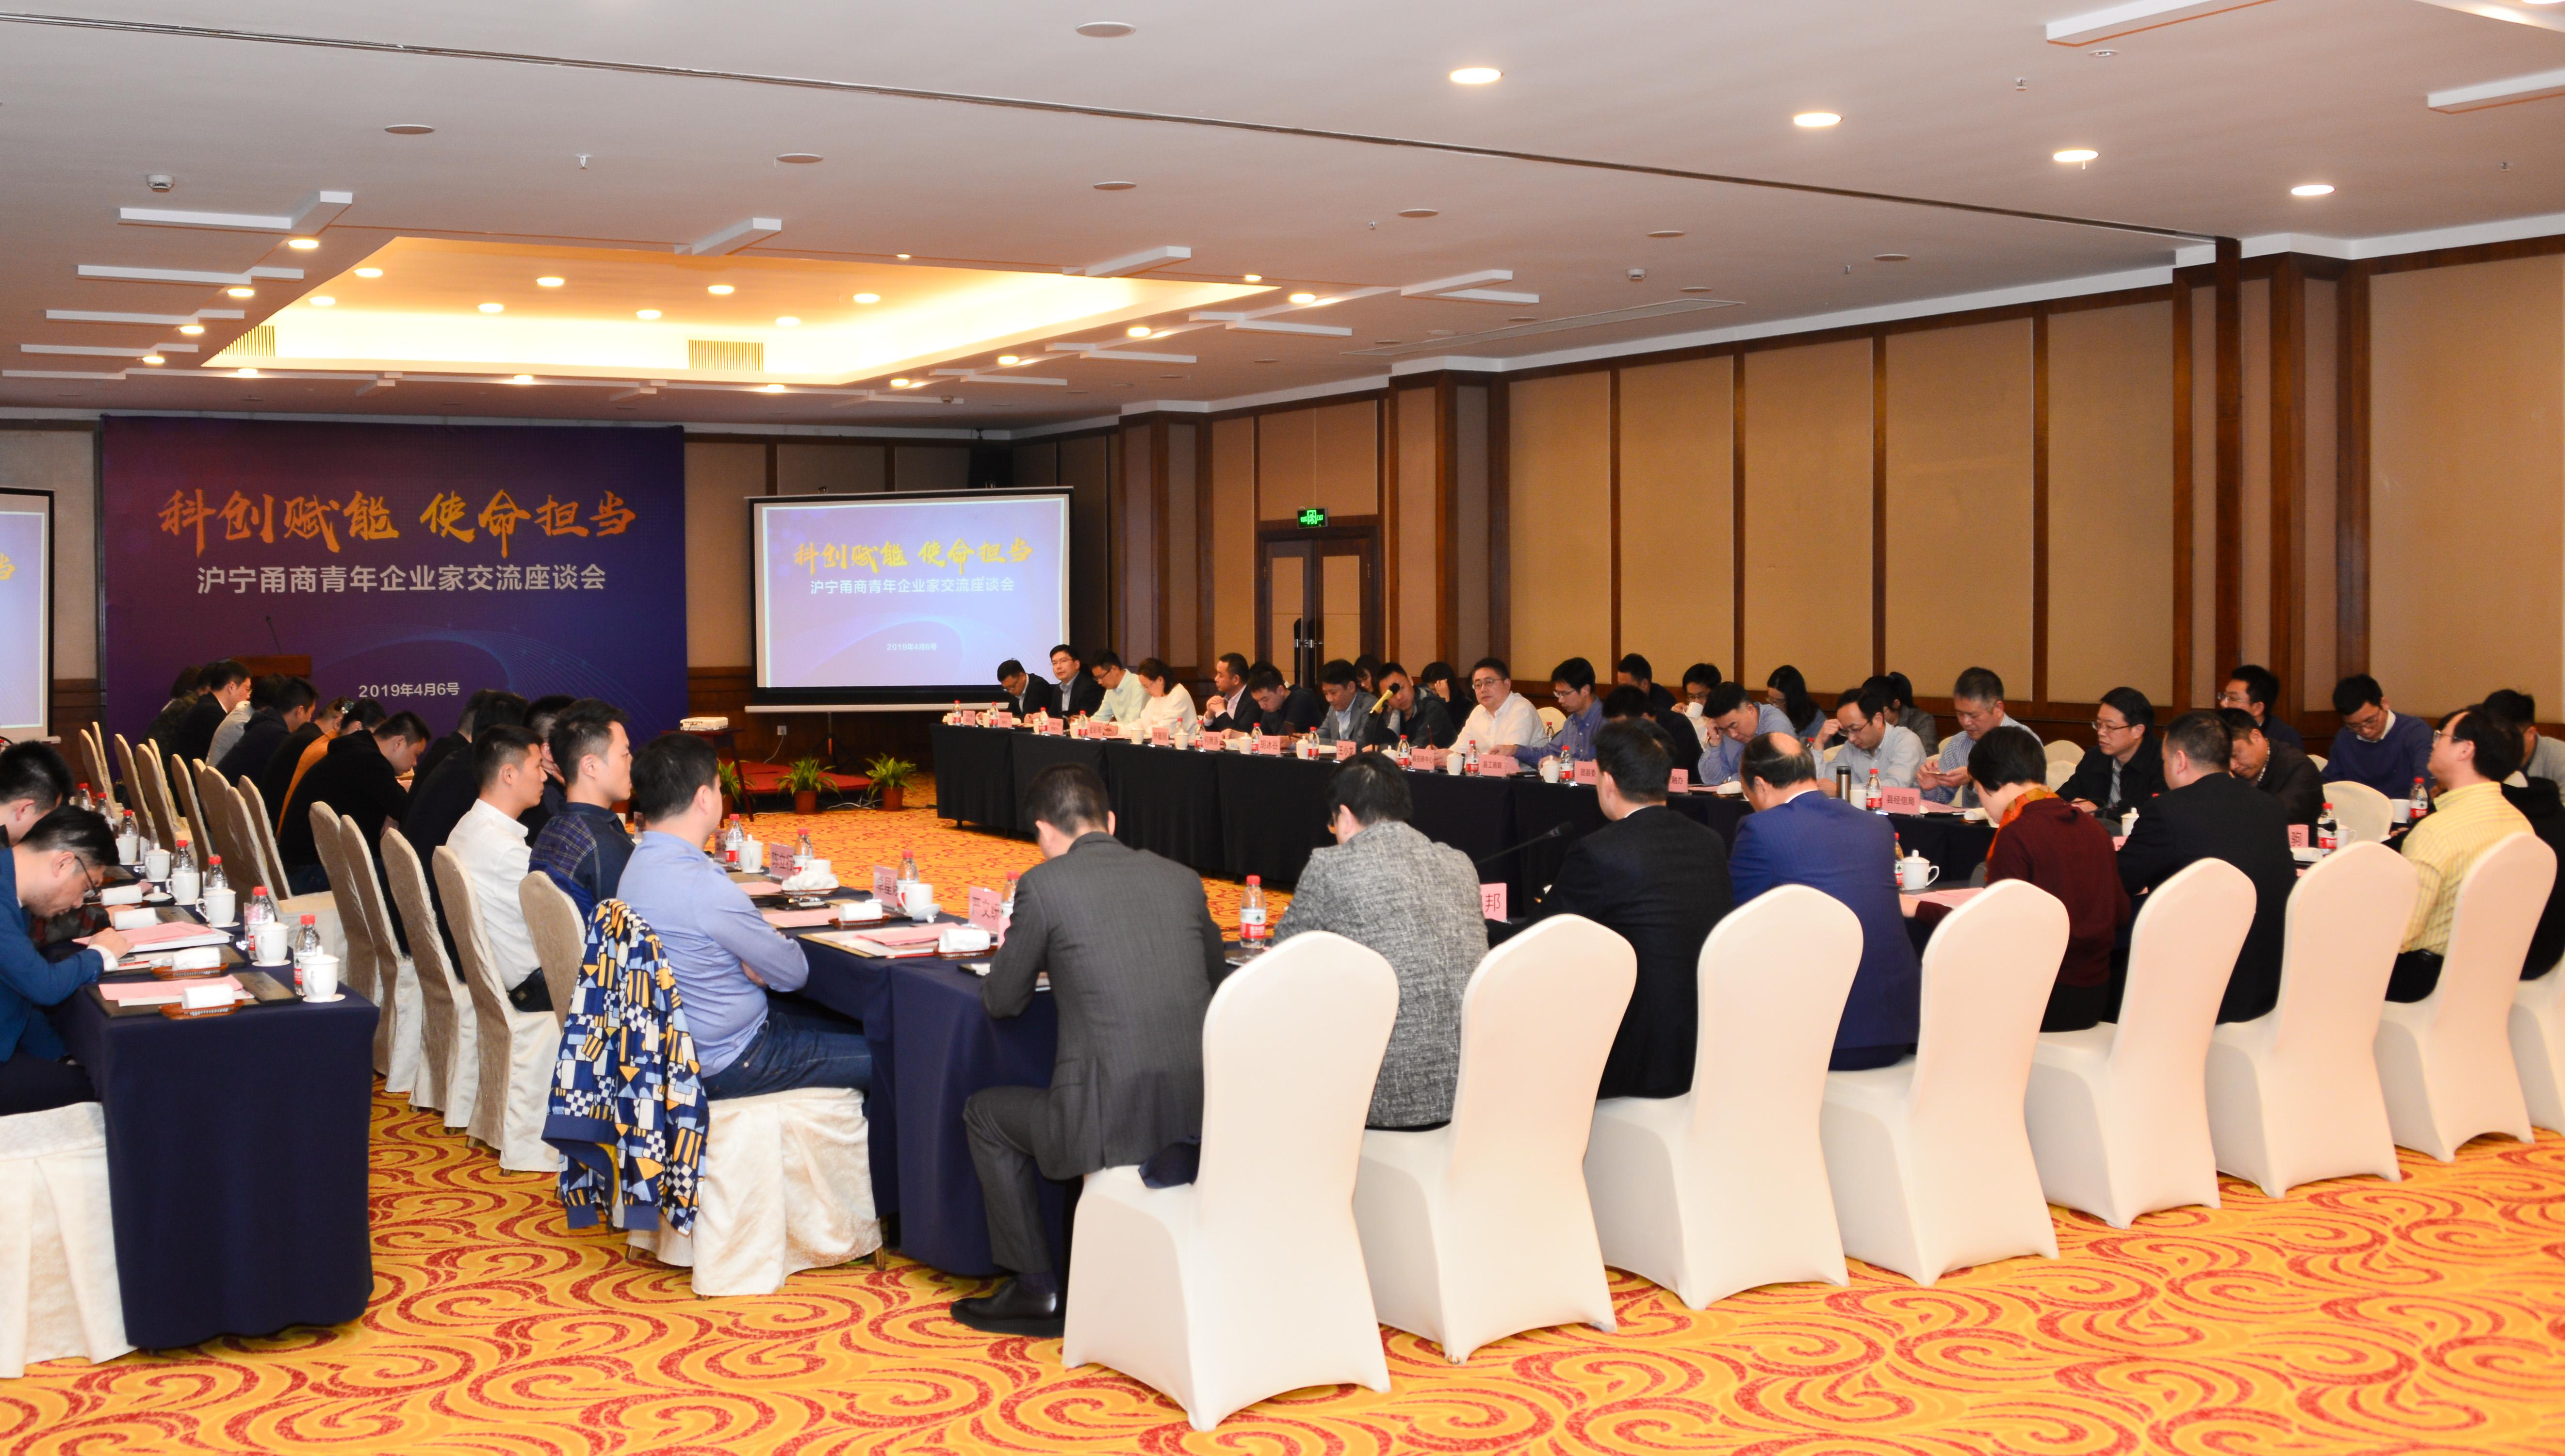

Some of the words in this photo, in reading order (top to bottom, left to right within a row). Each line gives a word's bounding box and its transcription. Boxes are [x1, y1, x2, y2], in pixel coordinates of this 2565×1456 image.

[158, 488, 399, 558] 科创赋能
[420, 489, 636, 558] 使命担当
[793, 541, 908, 576] 科创赋能
[918, 537, 1034, 575] 使命担当
[197, 564, 606, 594] 沪宁甬商青年企业家交流座谈会
[810, 577, 1015, 595] 沪宁甬商青年企业家交流座谈会
[359, 682, 460, 697] 2019年4月6号
[1887, 795, 1915, 806] 县经信局
